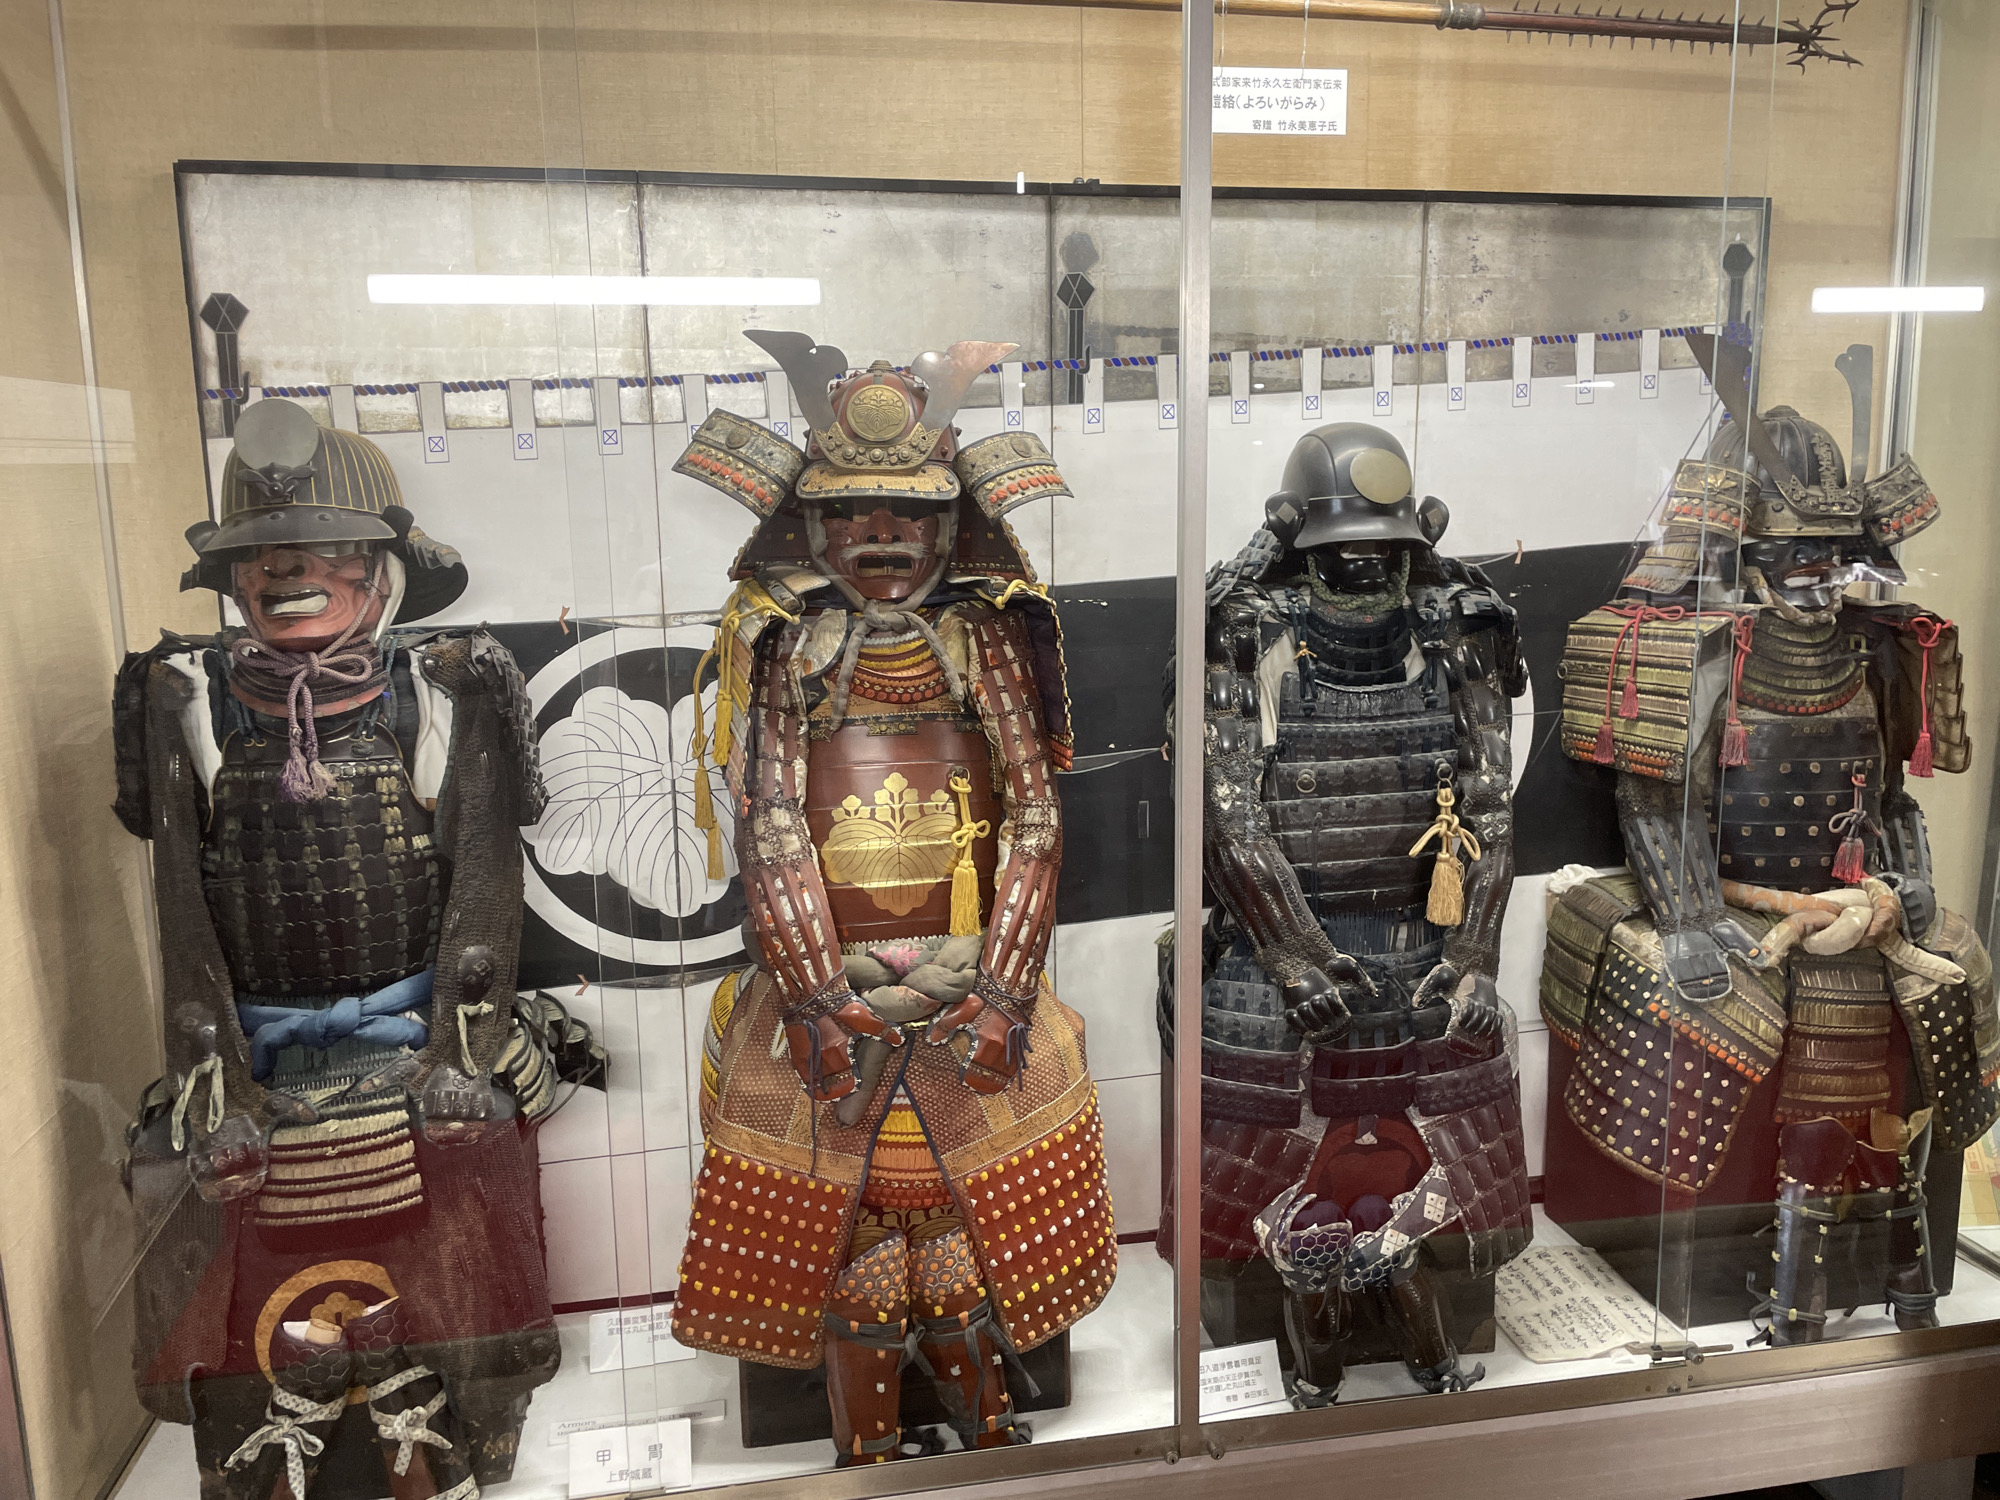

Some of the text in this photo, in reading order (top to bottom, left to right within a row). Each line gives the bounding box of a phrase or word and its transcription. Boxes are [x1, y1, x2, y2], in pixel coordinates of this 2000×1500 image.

[1252, 119, 1272, 130] 寄贈
[558, 1420, 597, 1429] Armors
[597, 1449, 611, 1466] 甲
